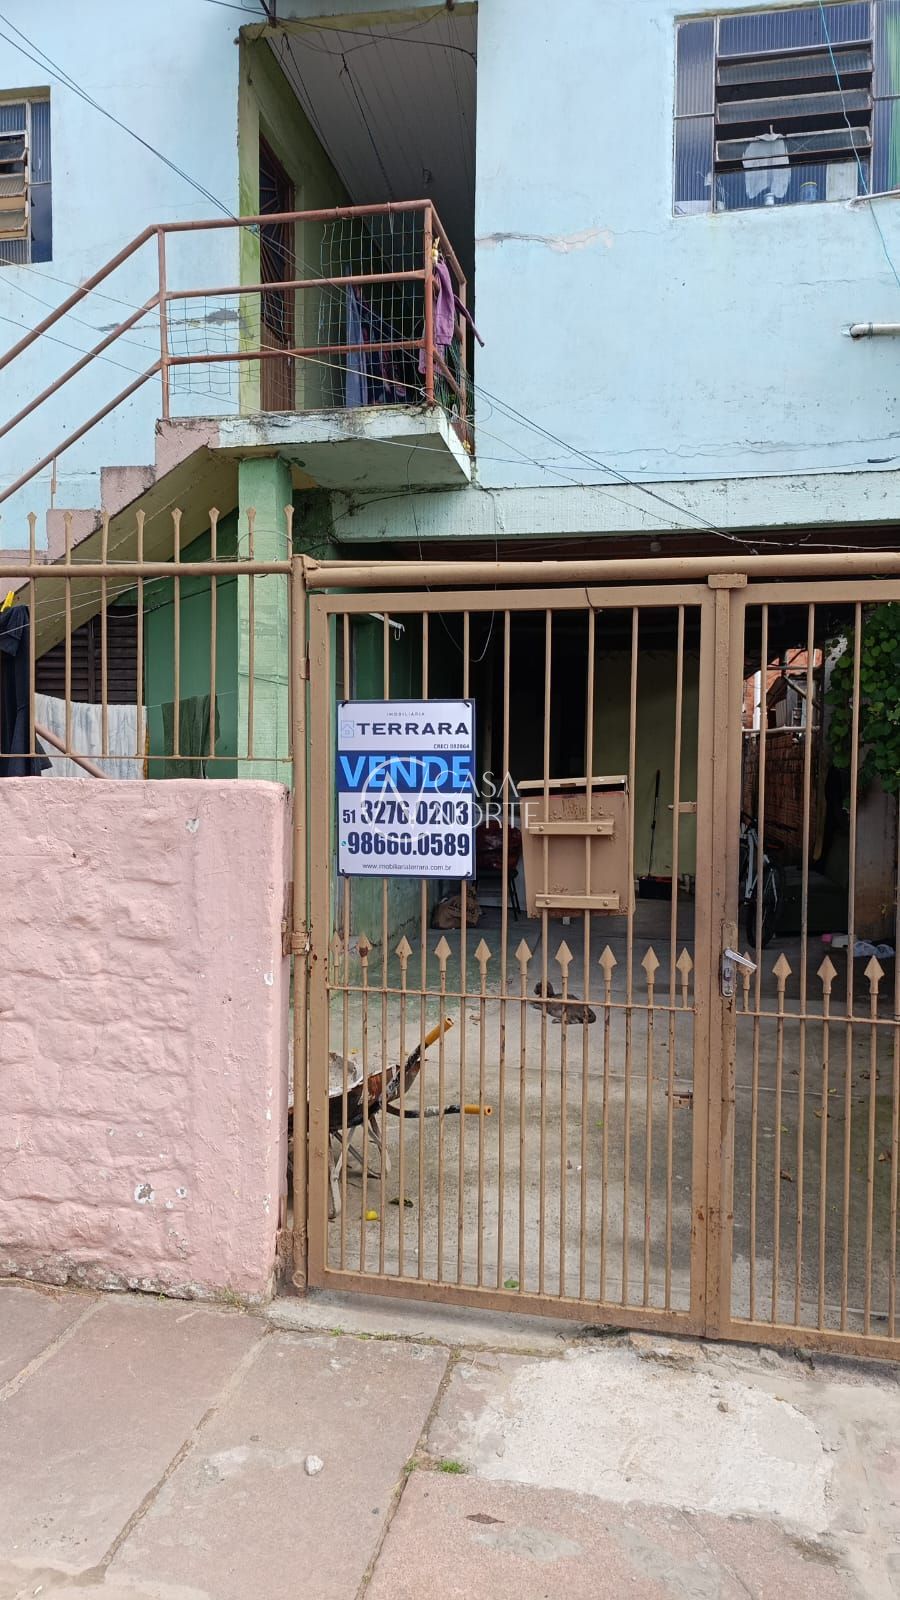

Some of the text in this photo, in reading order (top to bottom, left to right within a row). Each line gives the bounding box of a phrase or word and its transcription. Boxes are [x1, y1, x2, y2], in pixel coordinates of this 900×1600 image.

[356, 722, 470, 735] TERRARA
[339, 756, 471, 787] VENDE
[342, 800, 469, 825] 51 3276.0203
[347, 831, 470, 857] 98660.0589
